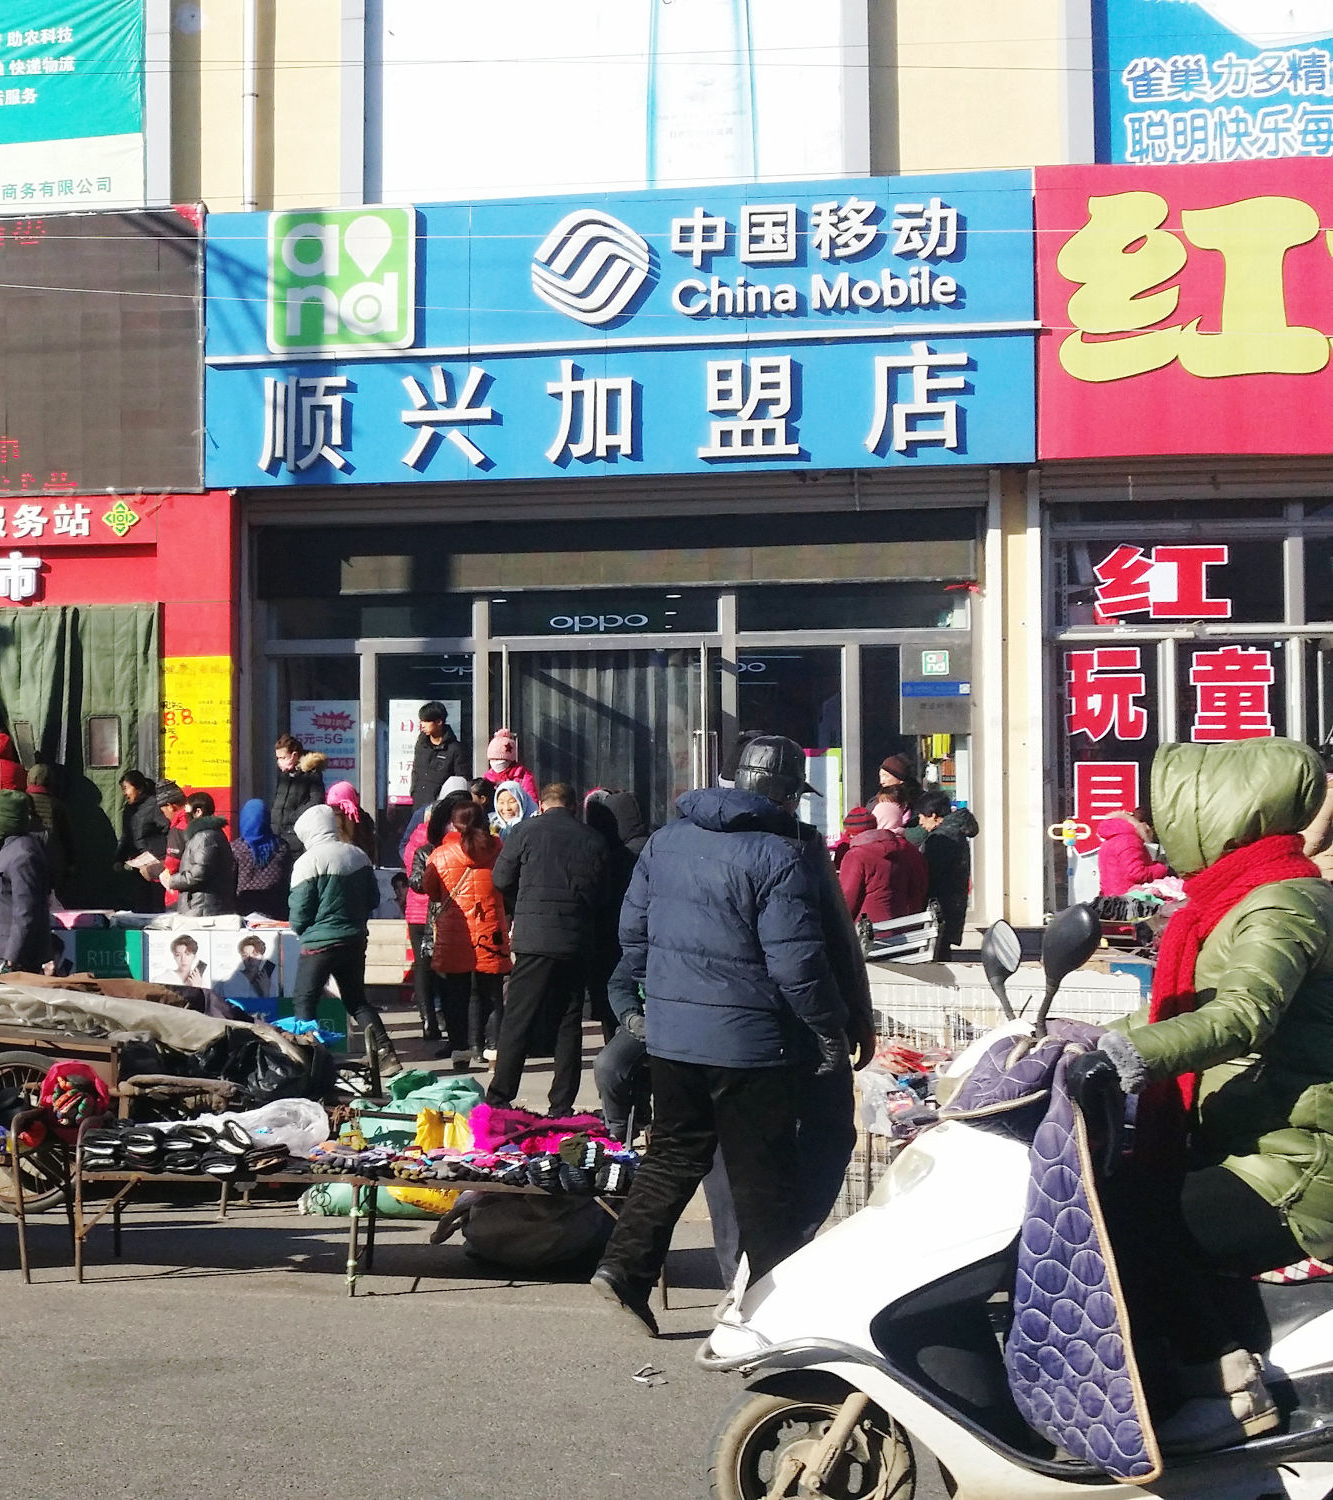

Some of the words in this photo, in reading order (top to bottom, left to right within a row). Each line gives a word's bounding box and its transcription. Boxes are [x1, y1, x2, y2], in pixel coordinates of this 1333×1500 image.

[7, 27, 74, 49] 助农科技
[9, 56, 75, 77] 快递物流
[1124, 49, 1328, 103] 雀巢力多精
[1124, 103, 1333, 165] 聪明快乐每
[671, 203, 959, 268] 中国移动
[671, 276, 798, 317] China
[811, 265, 957, 310] Mobile
[259, 343, 970, 473] 顺兴加盟店
[1094, 543, 1231, 618] 红
